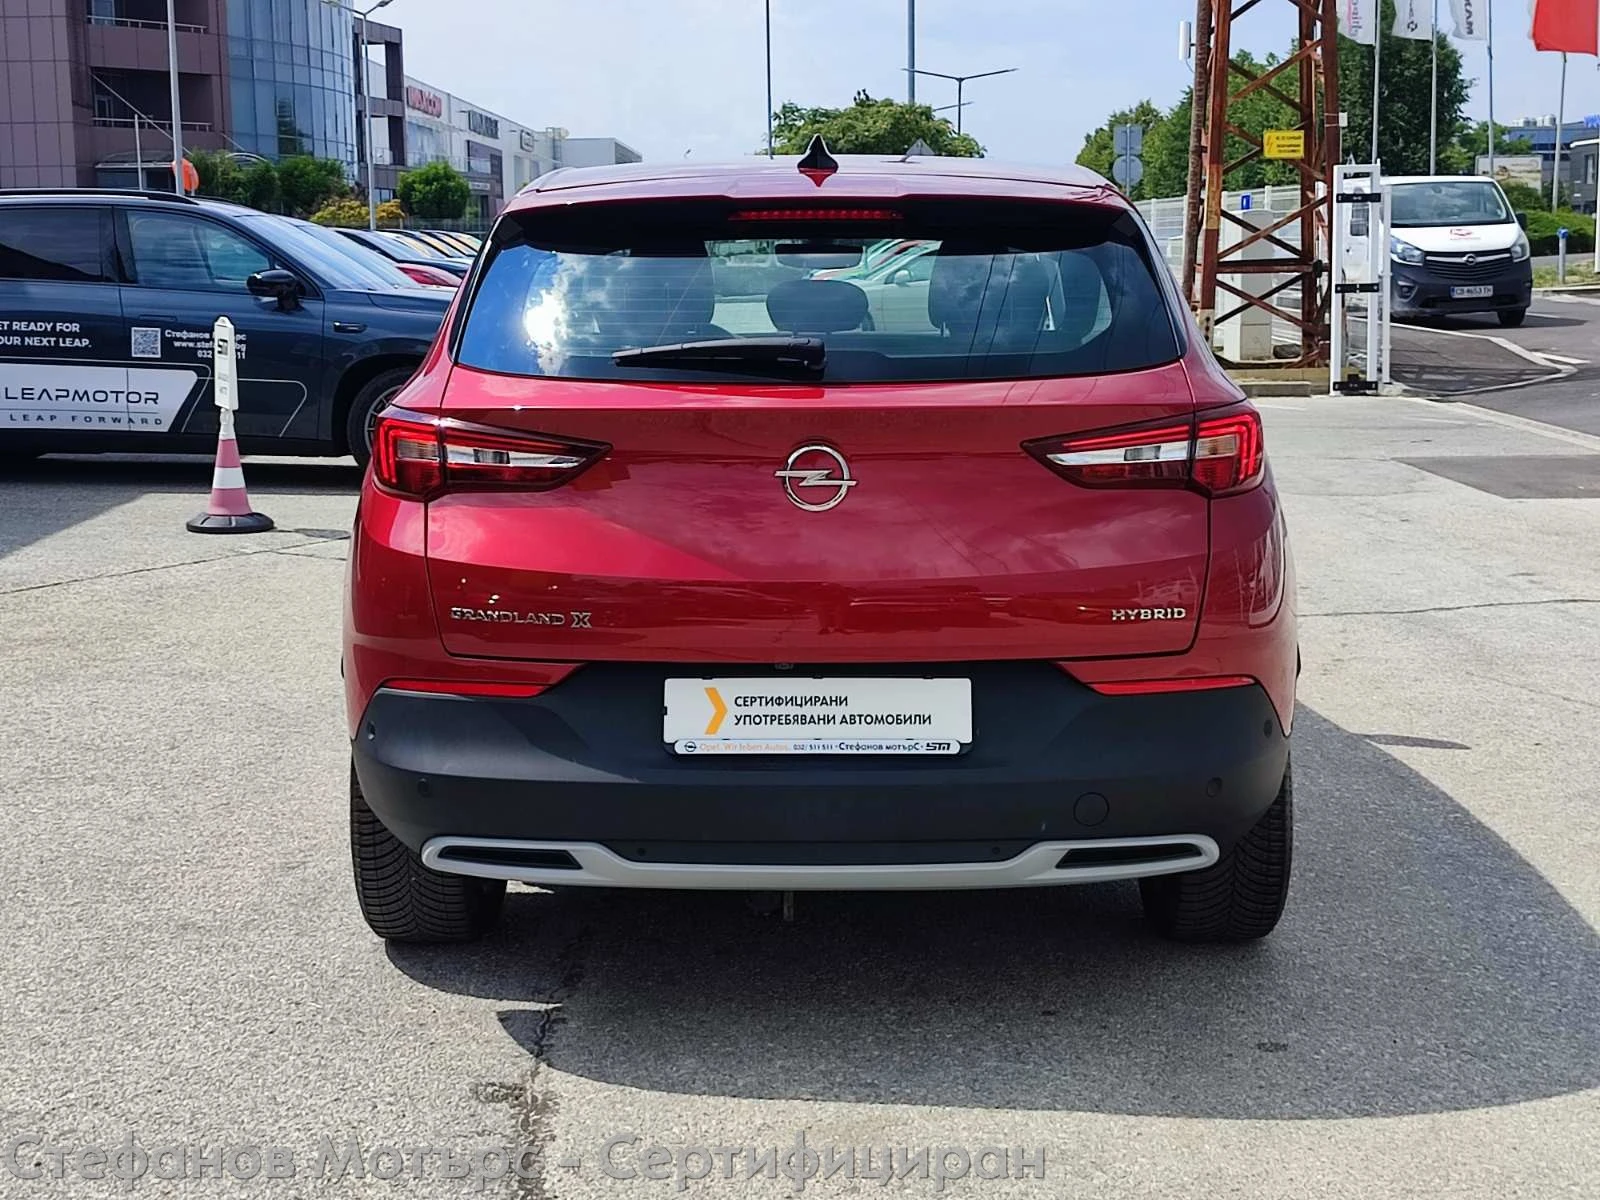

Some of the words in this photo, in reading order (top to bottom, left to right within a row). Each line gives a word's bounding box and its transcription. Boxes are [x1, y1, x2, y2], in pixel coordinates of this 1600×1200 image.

[12, 321, 54, 332] READY
[56, 322, 80, 333] FOR
[164, 329, 211, 340] Стефанов
[24, 336, 57, 347] NEXT
[59, 337, 92, 348] LEAP.
[5, 387, 160, 405] LEAPMOTOR
[9, 413, 58, 423] LEAP
[71, 415, 162, 426] FORWARD
[450, 606, 566, 626] GRANDLAND
[570, 611, 593, 629] X
[1111, 607, 1187, 621] HYBRID
[734, 695, 849, 708] СЕРТИФИЦИРАНИ
[734, 714, 836, 726] УПОТРЕБЯВАНИ
[839, 714, 932, 726] АВТОМОБИЛИ
[838, 741, 884, 752] Стефанов
